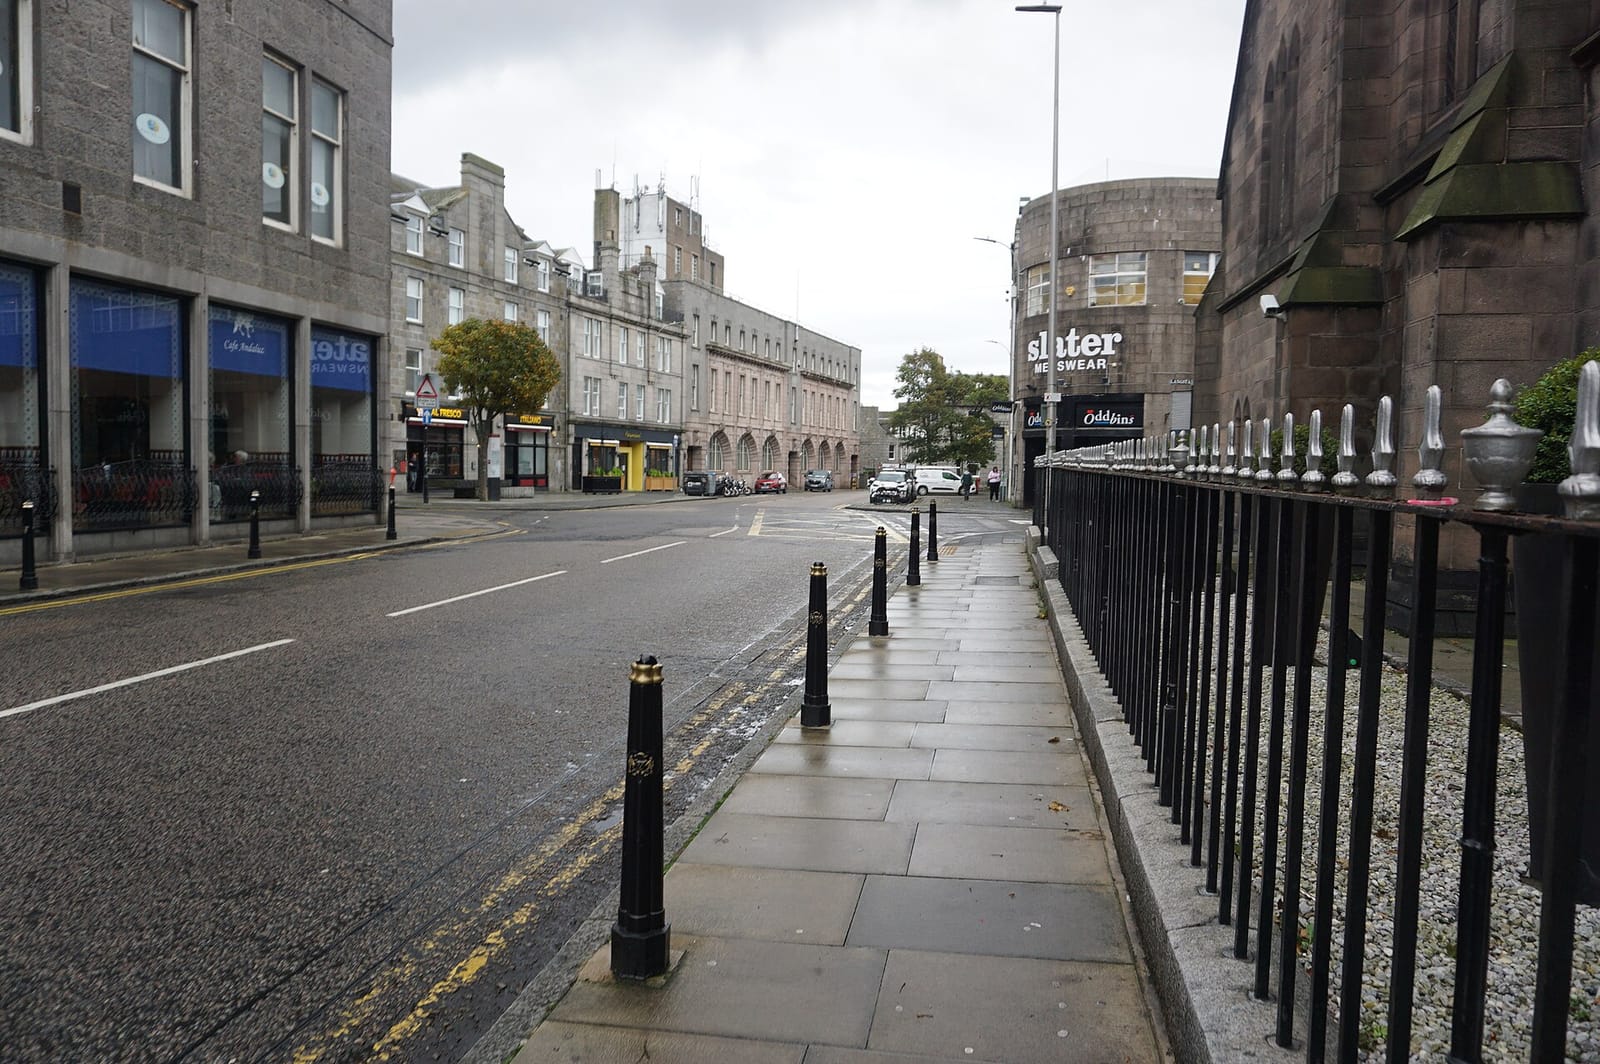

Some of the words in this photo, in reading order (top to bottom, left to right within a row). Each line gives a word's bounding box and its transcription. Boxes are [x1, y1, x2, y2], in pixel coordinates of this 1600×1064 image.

[1027, 327, 1123, 362] slater
[1034, 358, 1107, 374] MESWEAR
[439, 408, 462, 418] FRESCO
[1083, 409, 1135, 425] Oddbins
